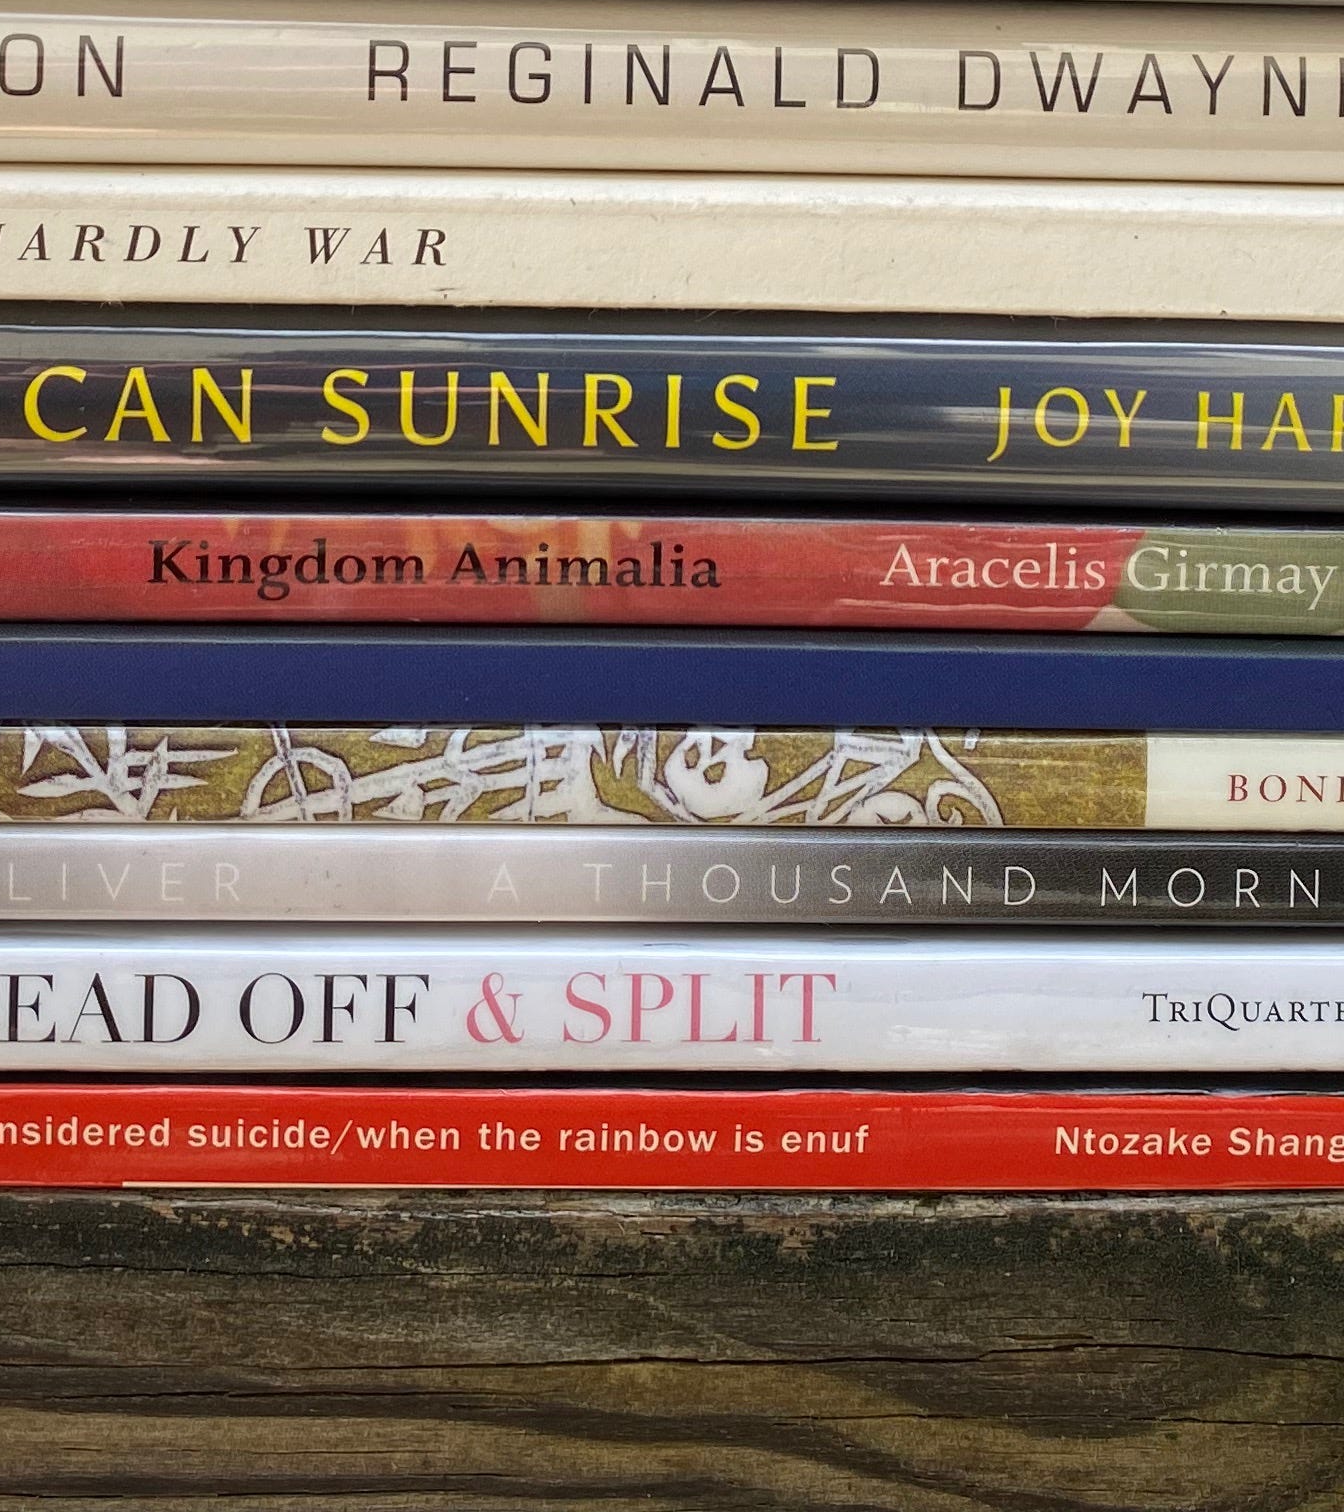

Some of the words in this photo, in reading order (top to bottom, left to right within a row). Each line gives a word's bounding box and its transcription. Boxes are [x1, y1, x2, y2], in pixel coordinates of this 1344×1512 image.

[367, 39, 880, 110] REGINALD
[302, 226, 447, 268] WAR
[320, 368, 840, 453] SUNRISE
[988, 386, 1147, 463] JOY
[148, 539, 424, 600] Kingdom
[449, 541, 722, 590] Animalia
[879, 541, 1106, 593] Aracelis
[1124, 549, 1336, 611] Girmay
[488, 862, 523, 905] A
[584, 863, 1036, 908] THOUSAND
[238, 974, 431, 1044] OFF
[465, 972, 525, 1045] &
[563, 972, 837, 1043] SPLIT
[186, 1117, 462, 1155] suicide/when
[479, 1122, 543, 1154] the
[558, 1122, 718, 1155] rainbow
[733, 1125, 764, 1155] is
[779, 1124, 871, 1156] enuf
[1055, 1125, 1214, 1157] Ntozake
